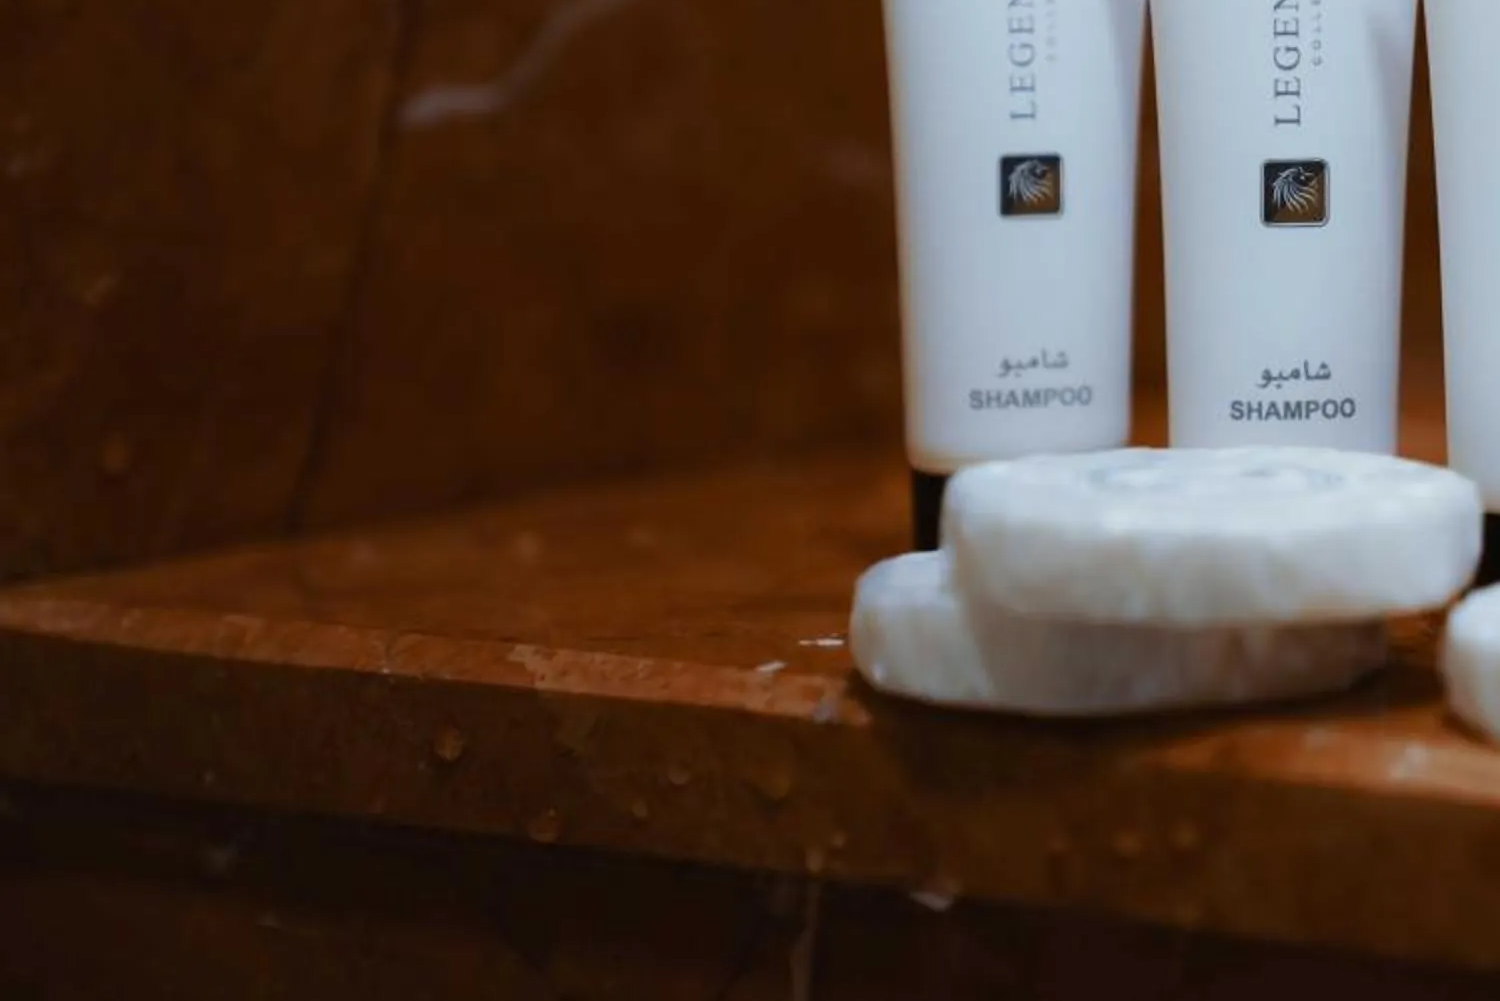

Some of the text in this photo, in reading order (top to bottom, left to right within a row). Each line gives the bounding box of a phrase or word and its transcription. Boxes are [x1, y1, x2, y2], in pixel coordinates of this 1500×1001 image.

[996, 347, 1069, 379] شامبو
[1256, 359, 1332, 389] شامبو
[969, 385, 1092, 410] SHAMPOO
[1230, 398, 1356, 421] SHAMPOO
